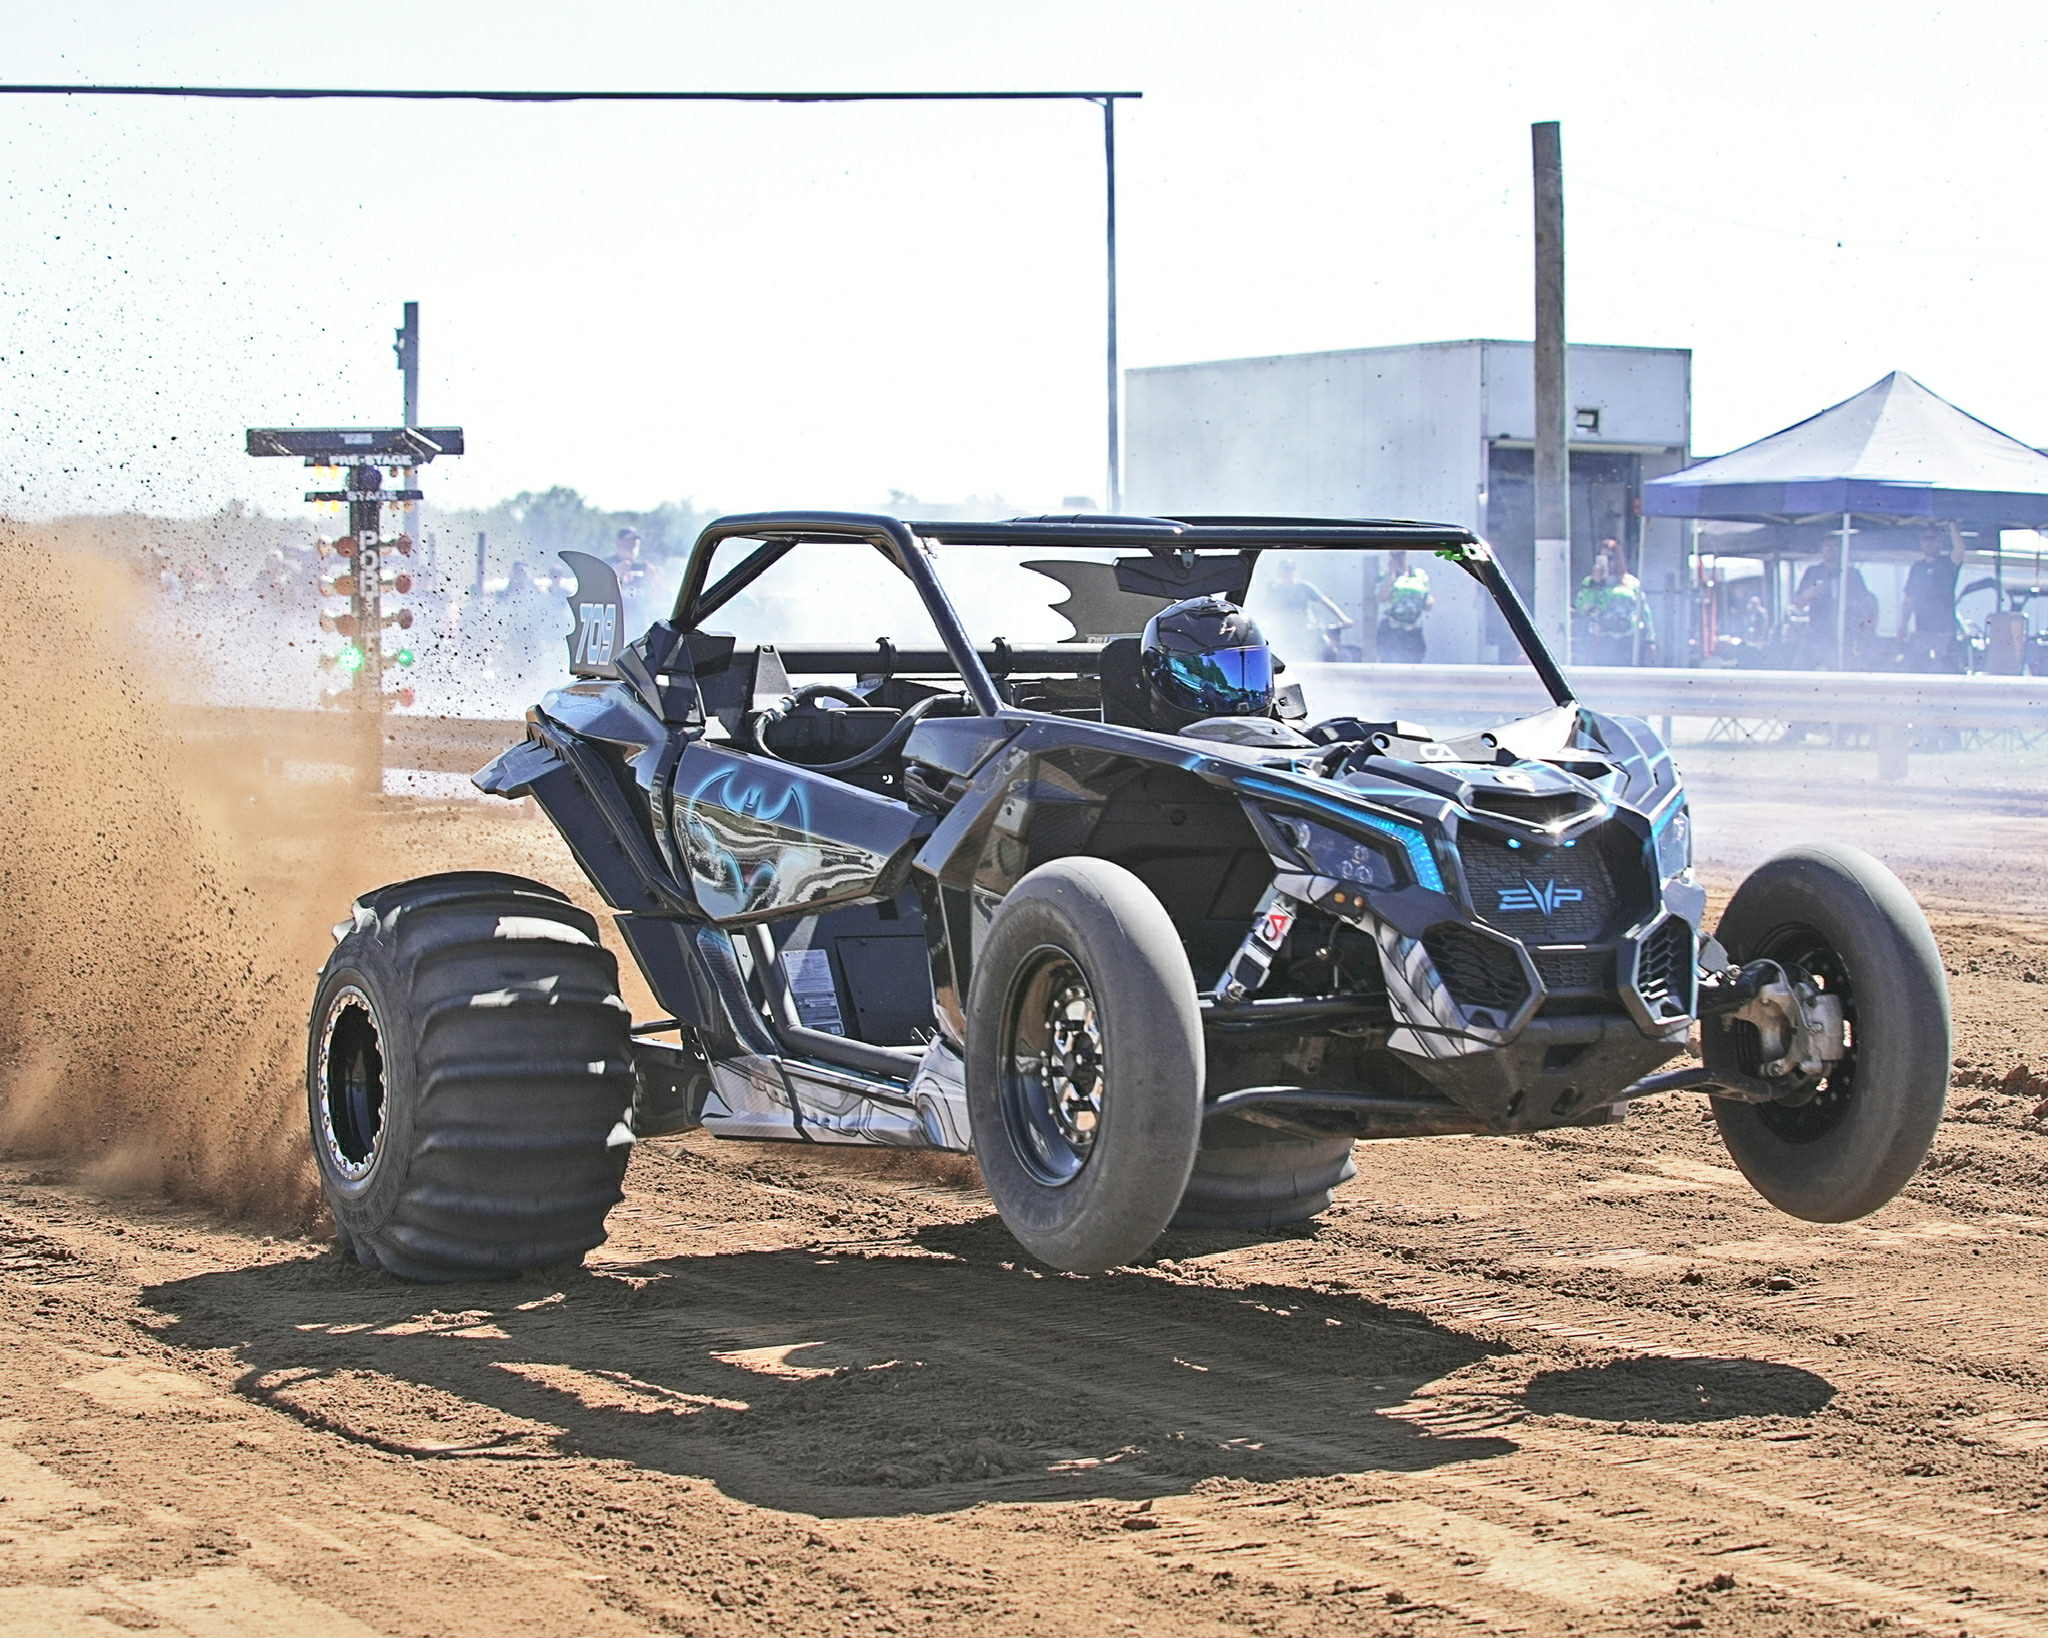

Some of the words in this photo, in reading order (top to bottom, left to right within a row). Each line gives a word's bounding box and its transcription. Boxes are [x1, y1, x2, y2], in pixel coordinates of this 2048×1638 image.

[328, 455, 412, 466] PRE-STAGE
[346, 490, 398, 501] STAGE
[575, 603, 616, 665] 709
[1497, 878, 1583, 916] EVP
